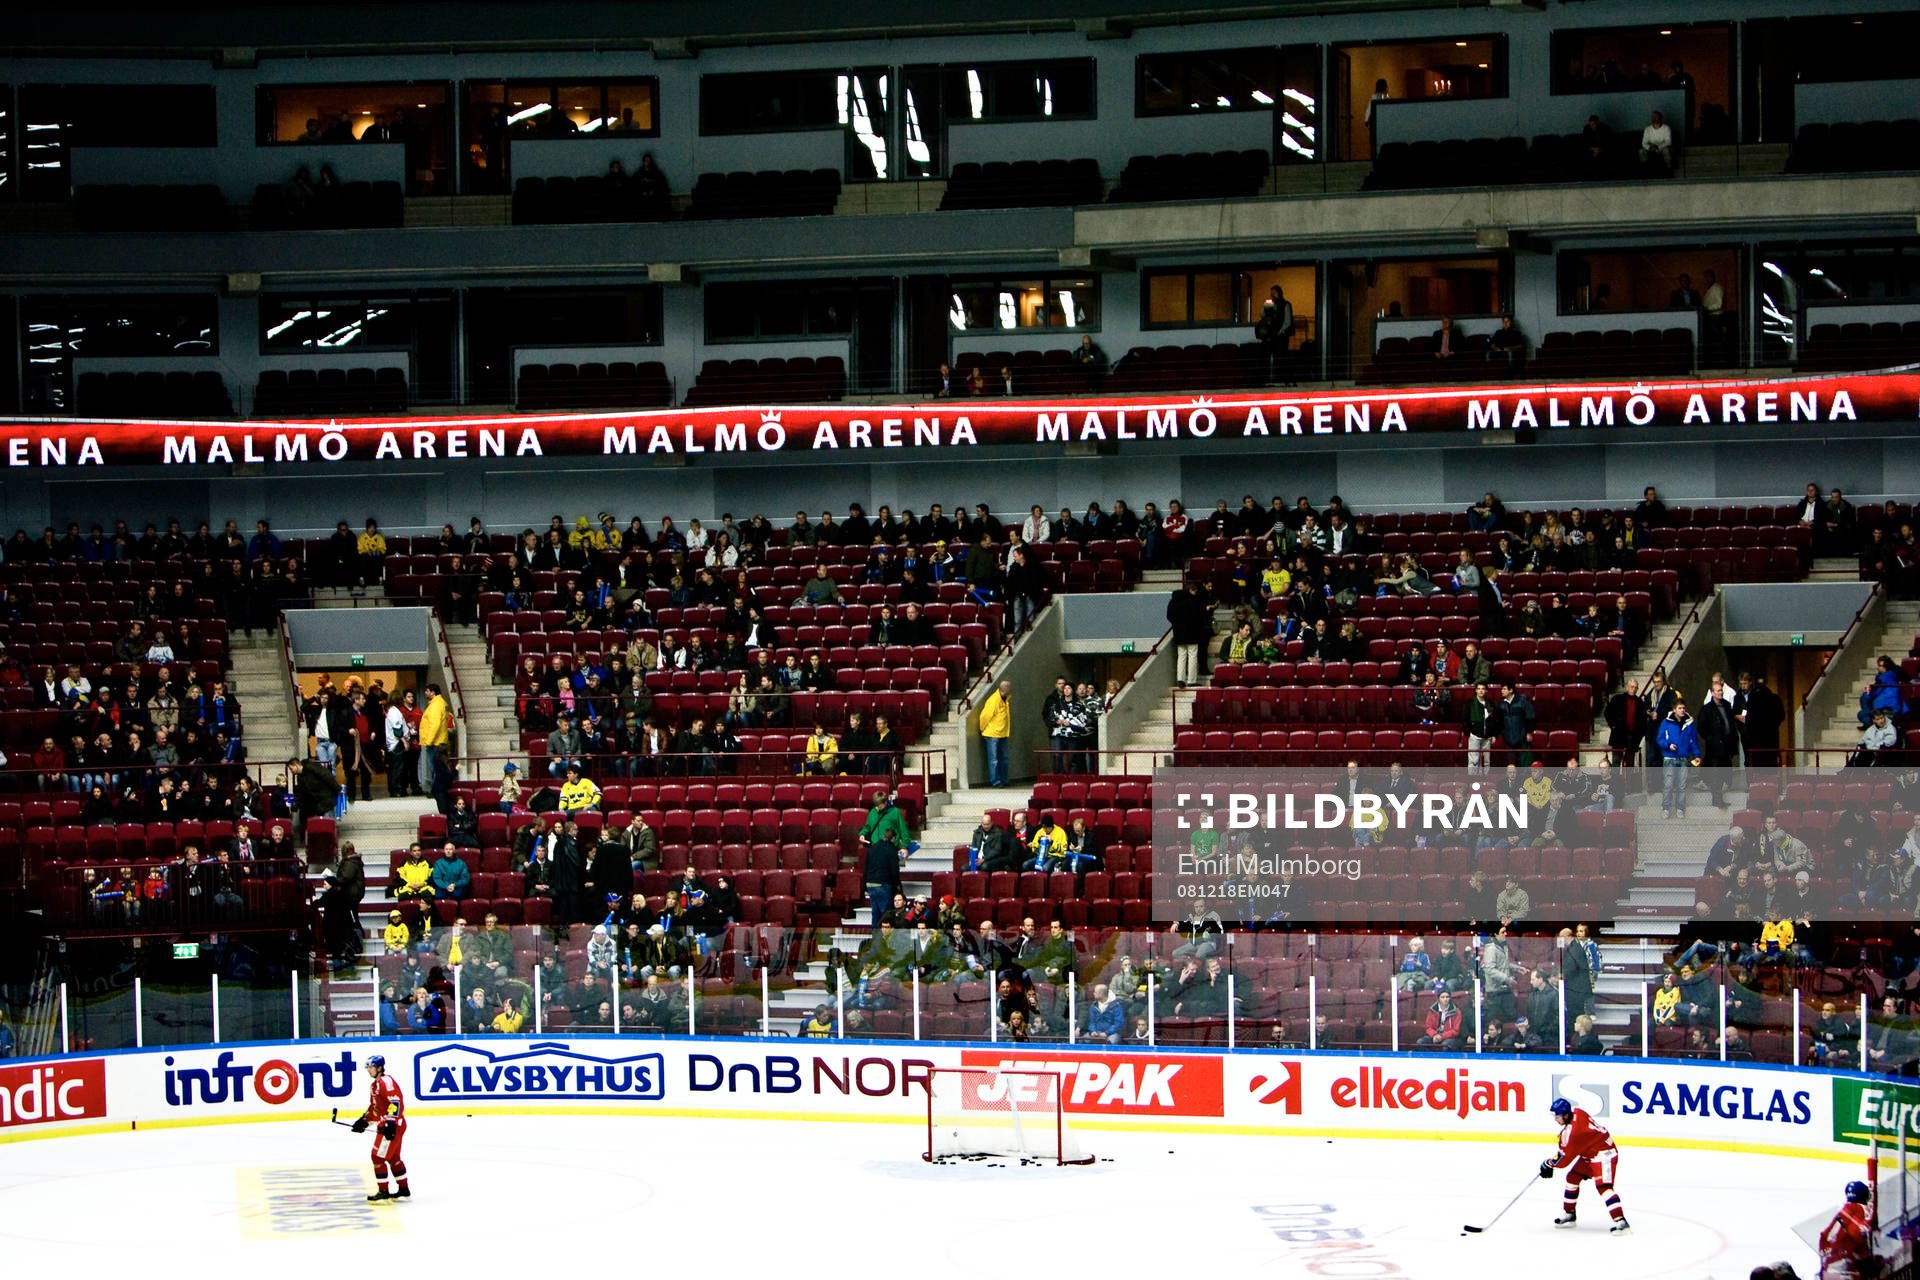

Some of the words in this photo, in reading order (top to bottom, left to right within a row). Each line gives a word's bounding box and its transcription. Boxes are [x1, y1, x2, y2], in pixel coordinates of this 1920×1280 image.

[1037, 396, 1218, 442] MALMÖ
[1244, 403, 1408, 436] ARENA
[1468, 382, 1655, 429] MALMÖ
[1684, 391, 1857, 424] ARENA
[164, 419, 348, 464] MALMÖ
[376, 429, 543, 460] ARENA
[604, 410, 786, 455] MALMÖ
[813, 417, 977, 449] ARENA
[164, 1051, 357, 1105] infront
[429, 1065, 653, 1094] ÄLVSBYHUS
[688, 1054, 802, 1094] DnB
[813, 1056, 936, 1097] NOR
[976, 1059, 1183, 1107] JETPAK
[1331, 1067, 1526, 1121] elkedjan
[1621, 1081, 1812, 1125] SAMGLAS
